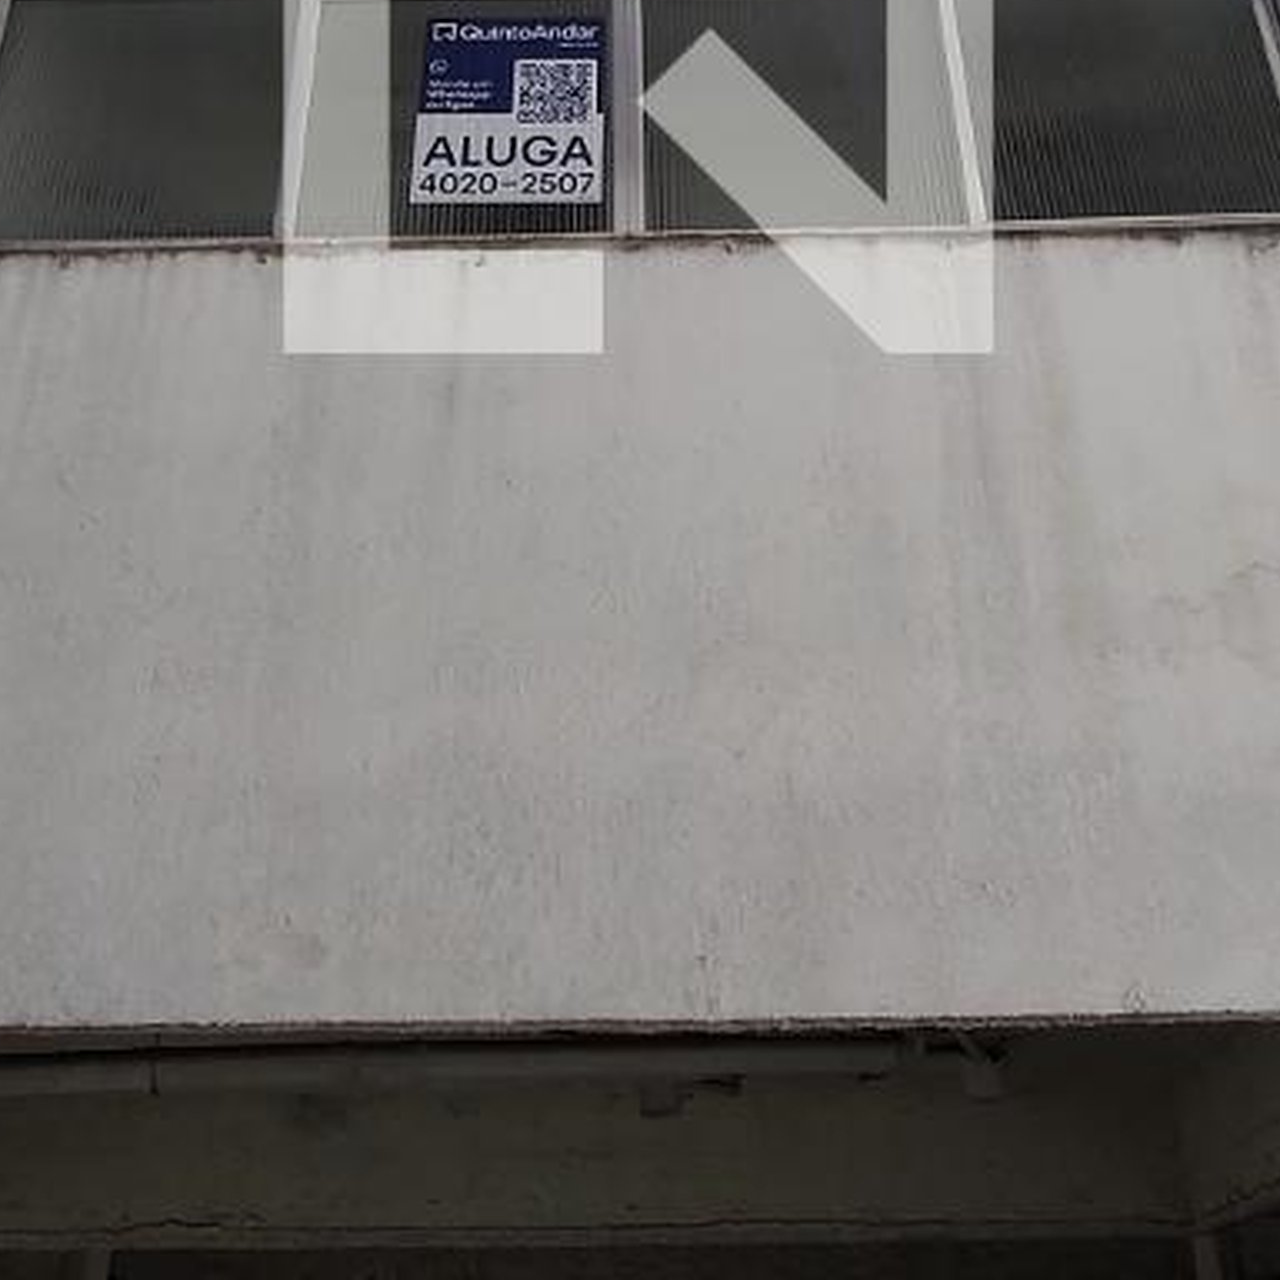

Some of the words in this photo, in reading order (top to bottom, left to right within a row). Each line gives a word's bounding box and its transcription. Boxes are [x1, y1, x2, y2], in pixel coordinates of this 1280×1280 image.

[459, 23, 599, 41] QuintoAndar
[423, 136, 592, 167] ALUGA
[420, 172, 594, 194] 4020-2507
